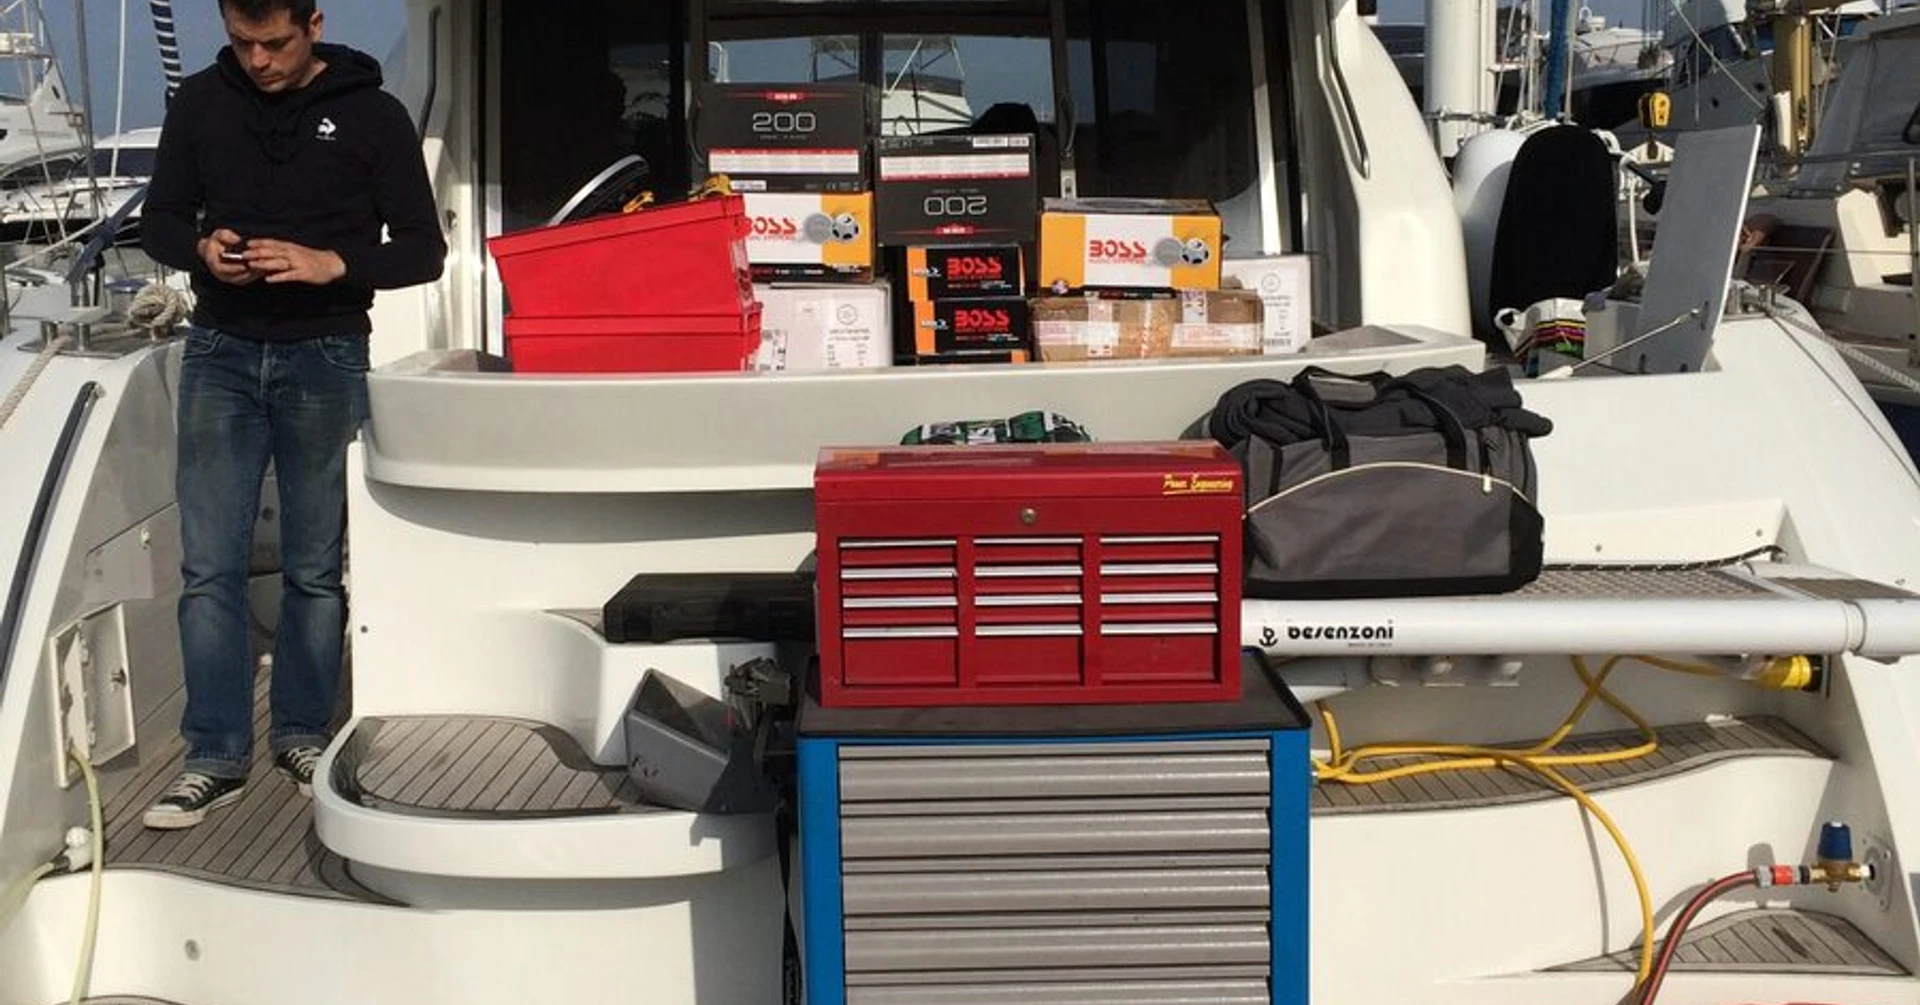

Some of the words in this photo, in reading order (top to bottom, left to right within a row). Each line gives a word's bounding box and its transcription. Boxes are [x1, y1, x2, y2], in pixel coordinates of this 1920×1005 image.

[752, 112, 816, 132] 200
[923, 196, 988, 216] 200
[1089, 239, 1147, 258] BOSS
[946, 257, 1002, 275] BOSS
[955, 309, 1009, 327] BOSS
[1287, 618, 1394, 640] besenzoni
